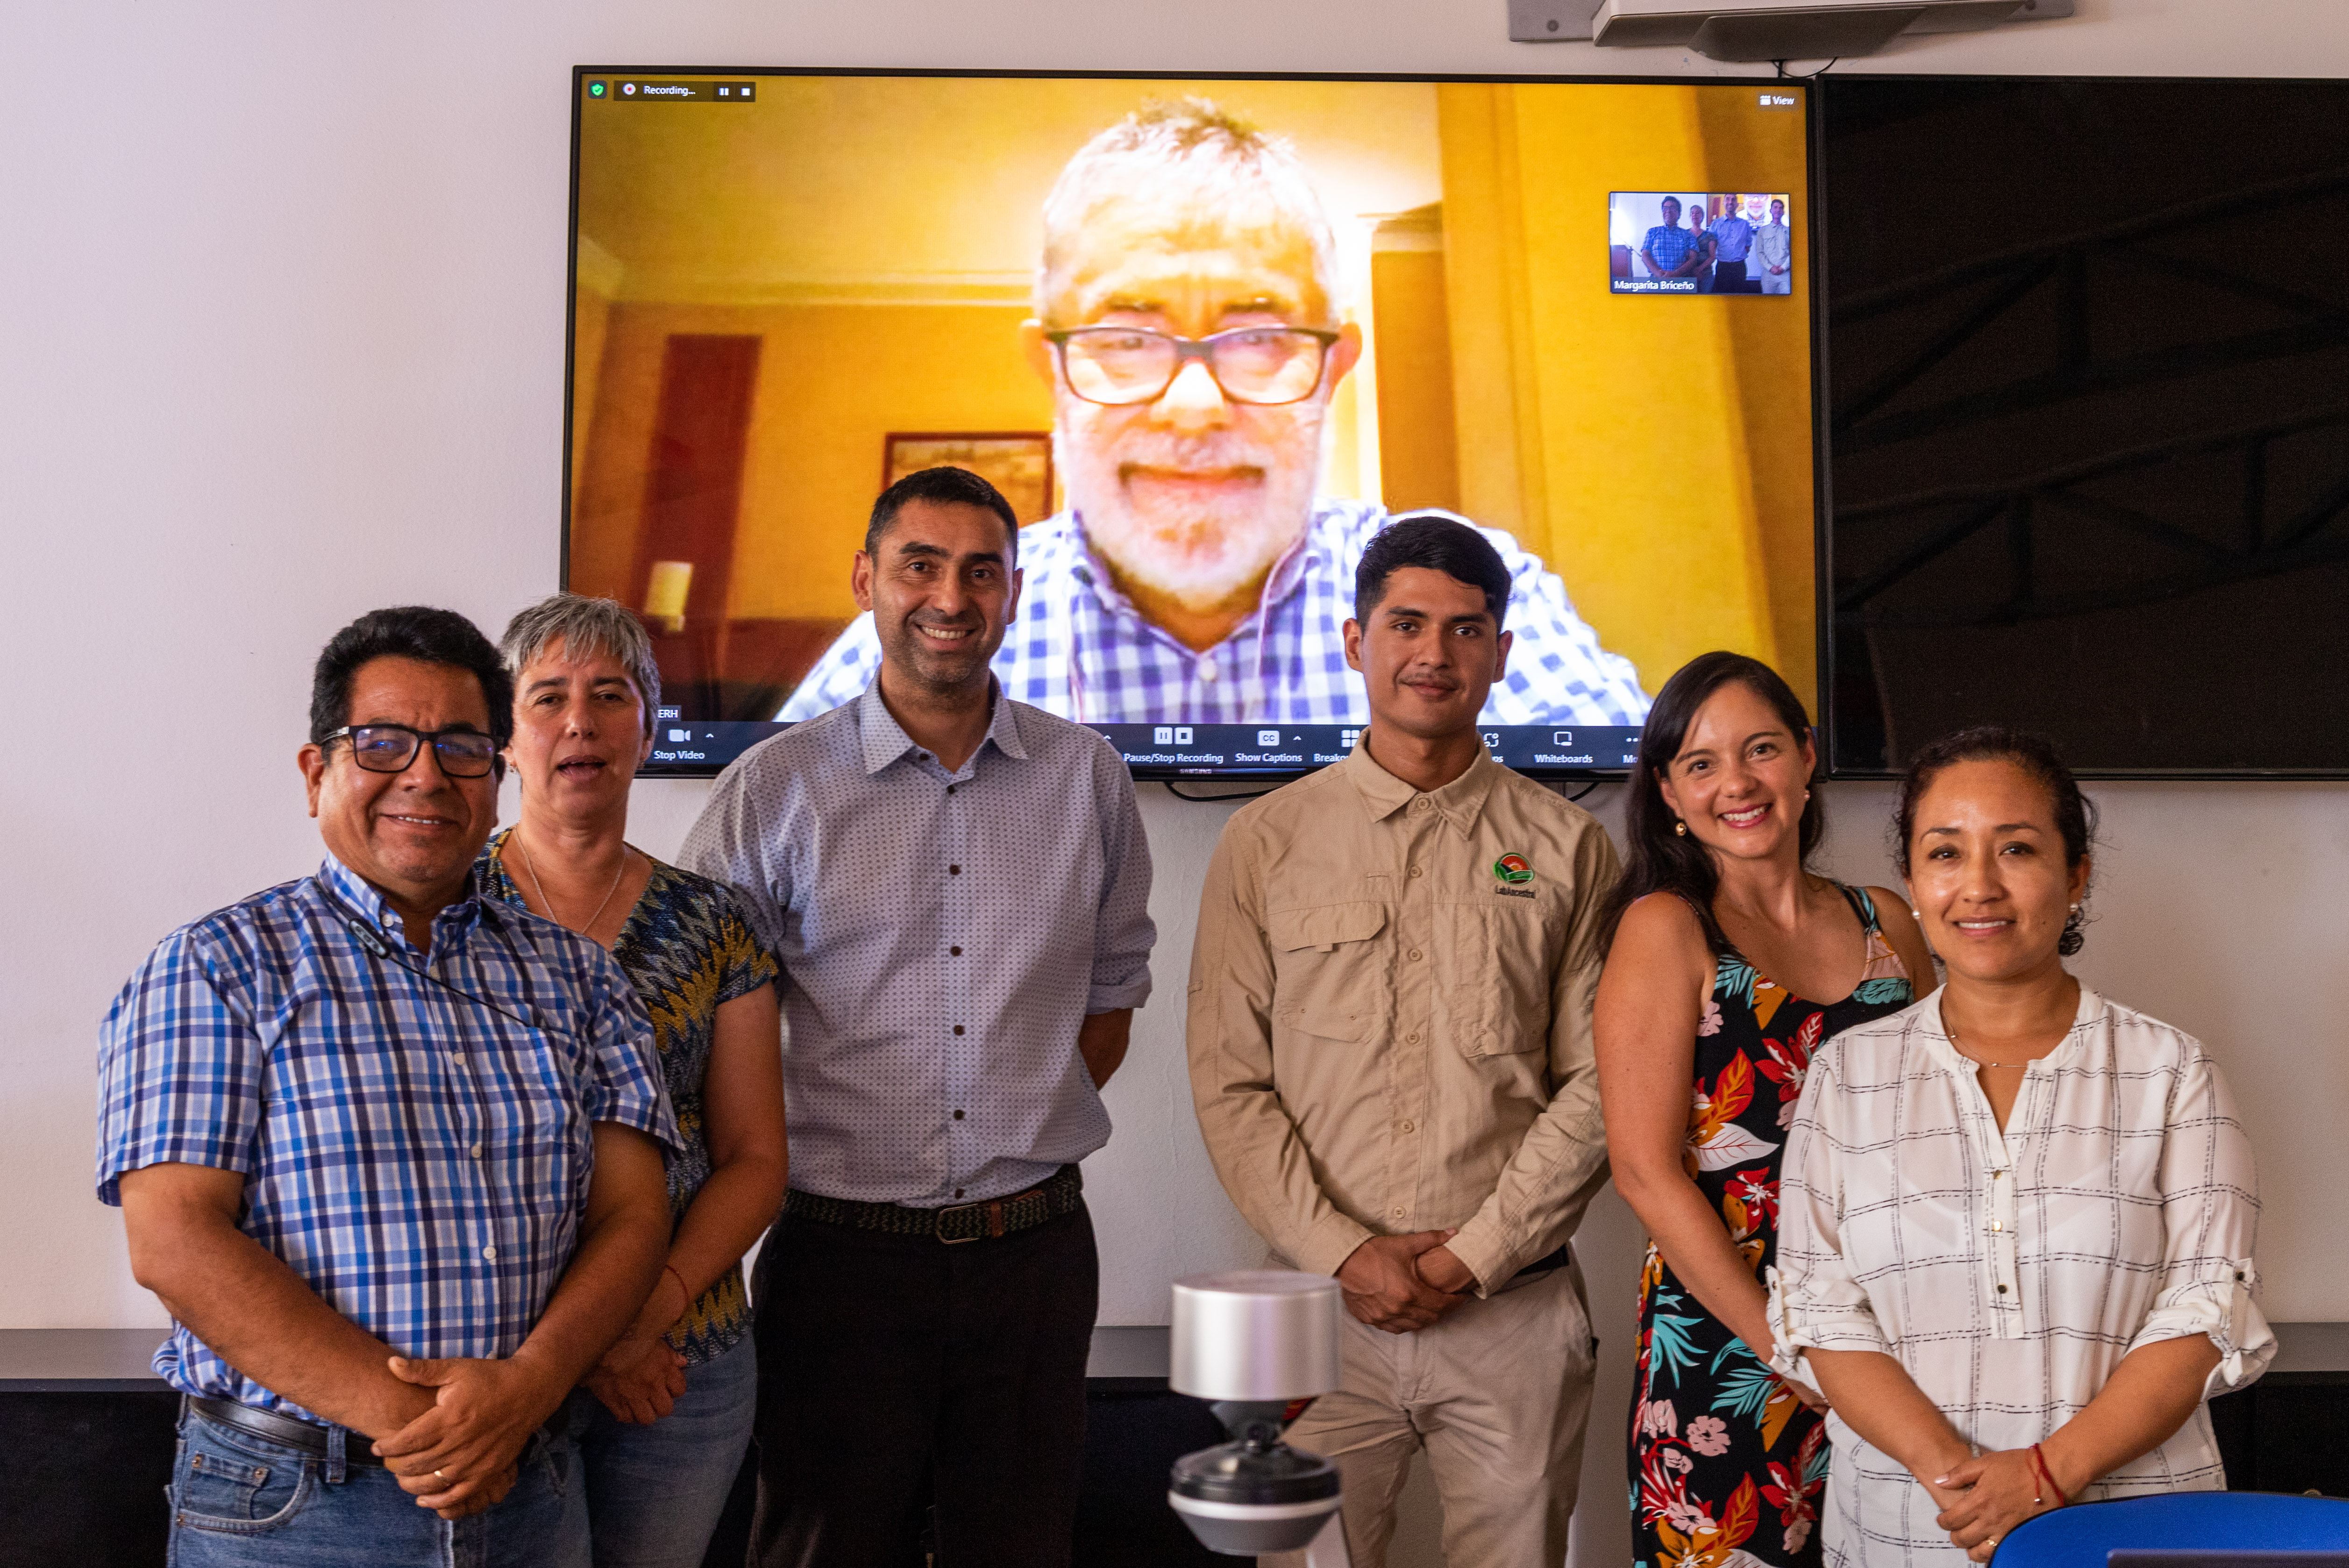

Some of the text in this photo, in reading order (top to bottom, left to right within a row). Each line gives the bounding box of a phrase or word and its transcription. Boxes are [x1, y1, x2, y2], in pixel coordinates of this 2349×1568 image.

[643, 85, 696, 96] Recording...
[1772, 96, 1795, 105] View
[1614, 280, 1694, 292] Margarita Briceño
[654, 750, 705, 761] Stop Video
[1123, 753, 1224, 764] Pause/Stop Recording
[1235, 753, 1303, 763] Show Captions
[1534, 754, 1593, 763] Whiteboards
[1623, 755, 1638, 763] Mo
